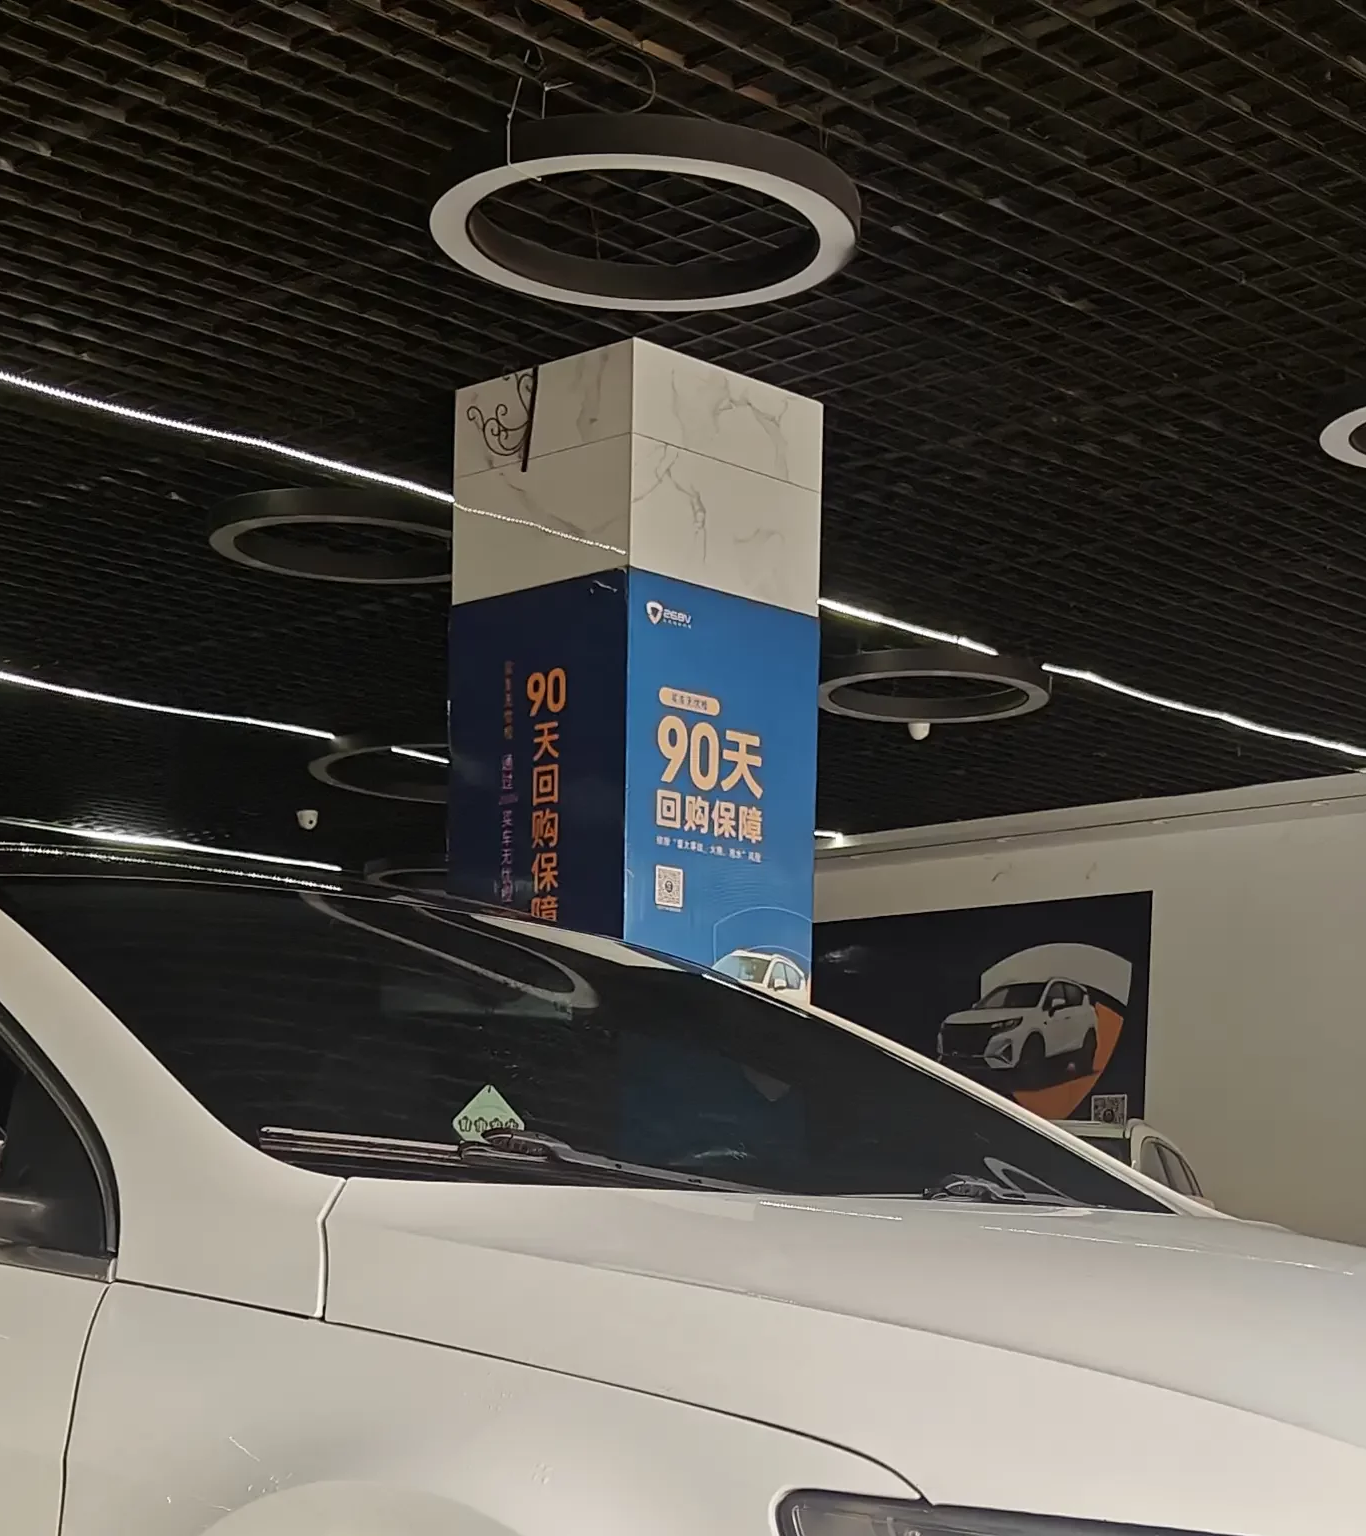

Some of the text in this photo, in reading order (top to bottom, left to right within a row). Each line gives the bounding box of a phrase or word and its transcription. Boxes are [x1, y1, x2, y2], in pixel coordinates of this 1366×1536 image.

[656, 715, 764, 800] 90天
[655, 790, 764, 844] 回购保障
